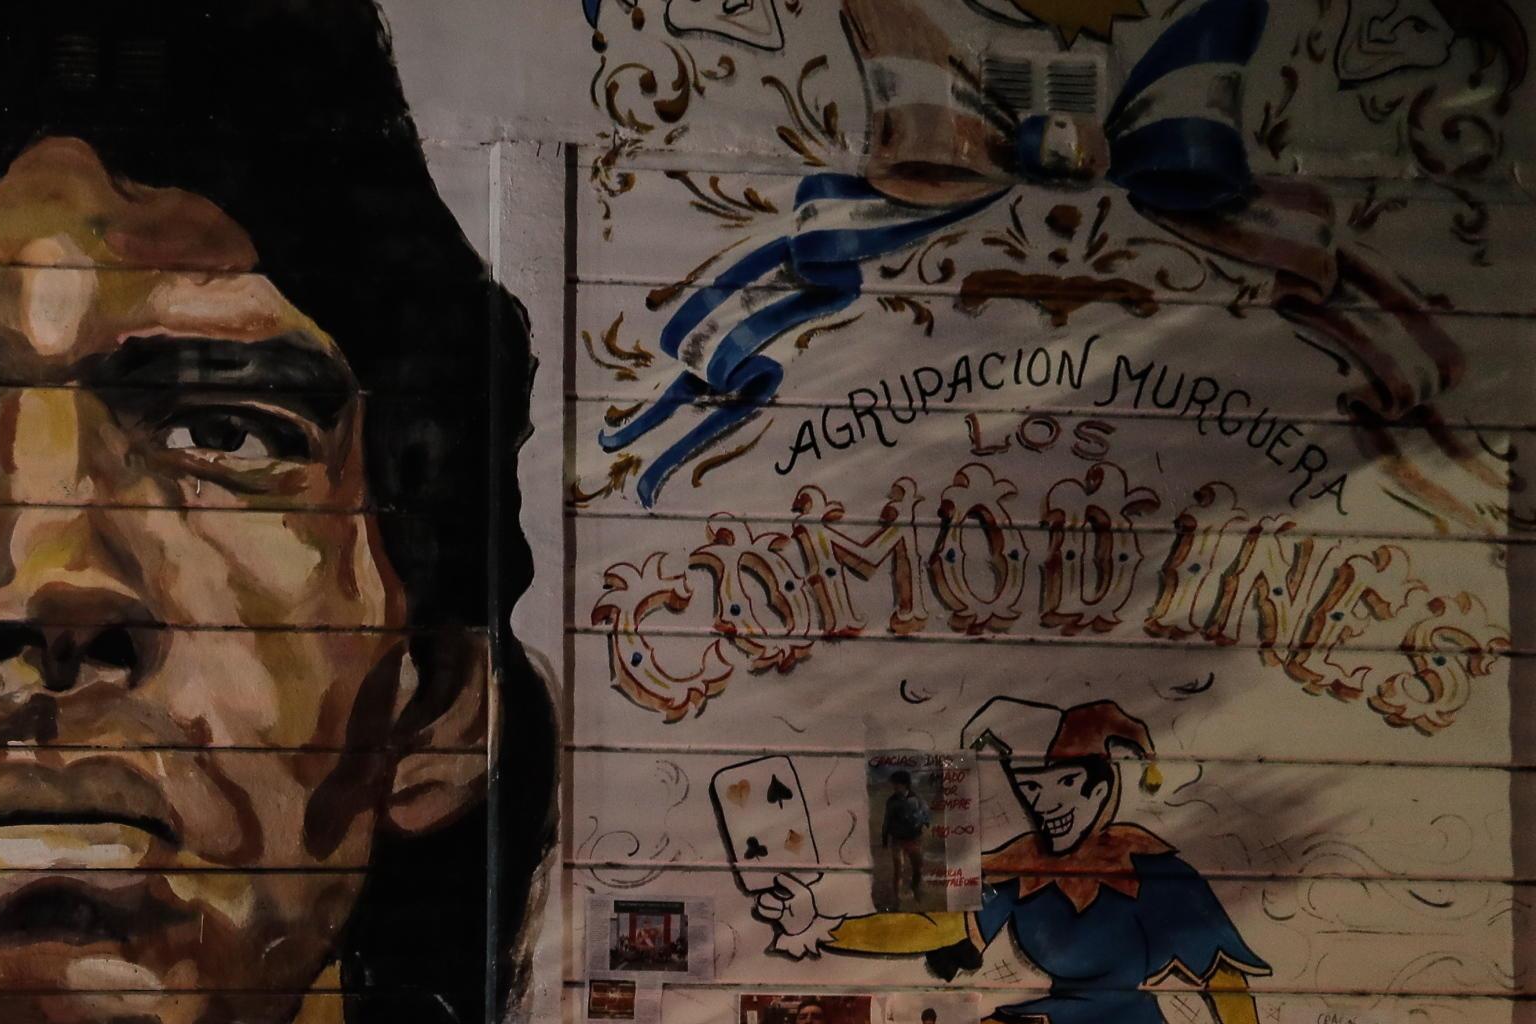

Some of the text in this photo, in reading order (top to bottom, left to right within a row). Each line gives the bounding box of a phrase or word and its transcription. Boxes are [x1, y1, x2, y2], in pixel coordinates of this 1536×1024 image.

[775, 335, 1349, 516] AGRUPACION MURGUERA
[965, 412, 1117, 460] LOS
